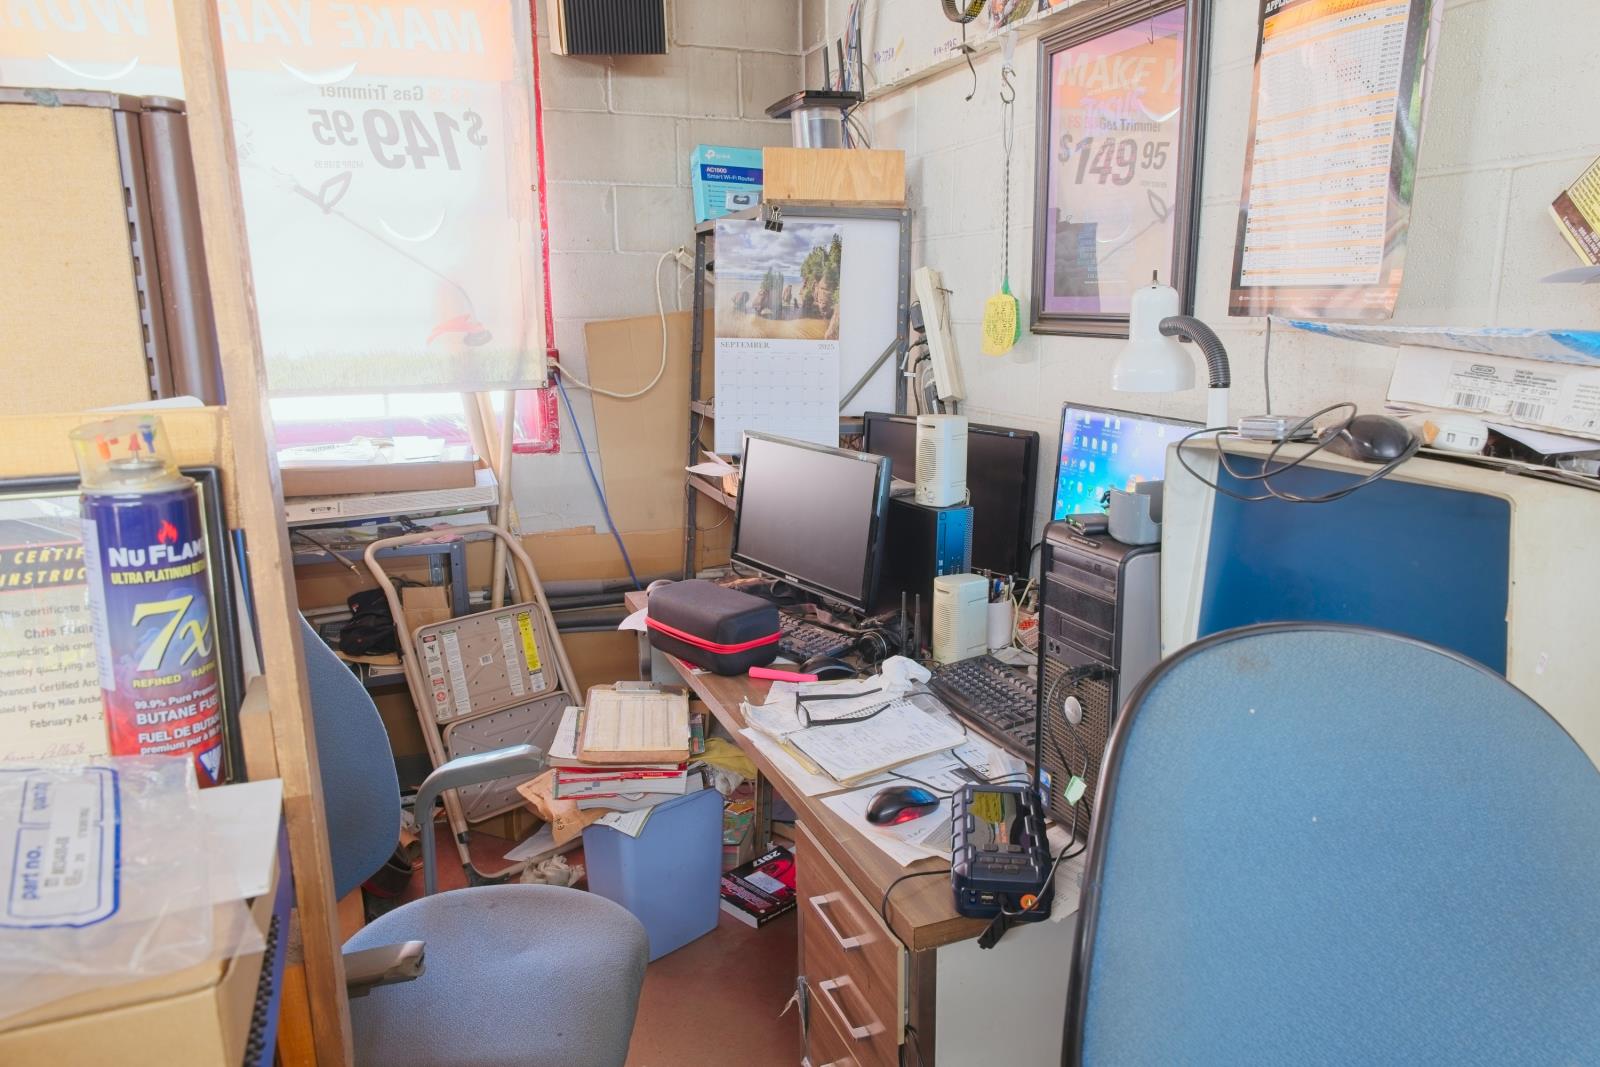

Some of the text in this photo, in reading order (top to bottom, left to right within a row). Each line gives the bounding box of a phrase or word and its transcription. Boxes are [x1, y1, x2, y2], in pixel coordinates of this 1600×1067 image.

[1056, 50, 1157, 90] MAKE
[720, 341, 770, 349] SEPTEMBER
[111, 571, 145, 585] ULTRA
[39, 679, 80, 693] Certified
[132, 674, 182, 689] REFINED
[168, 693, 192, 706] Pure
[30, 717, 73, 729] February
[75, 713, 88, 724] 24
[136, 703, 198, 726] BUTANE
[138, 730, 172, 743] FUEL
[174, 726, 191, 739] DE
[140, 741, 186, 756] premium
[20, 872, 40, 900] part
